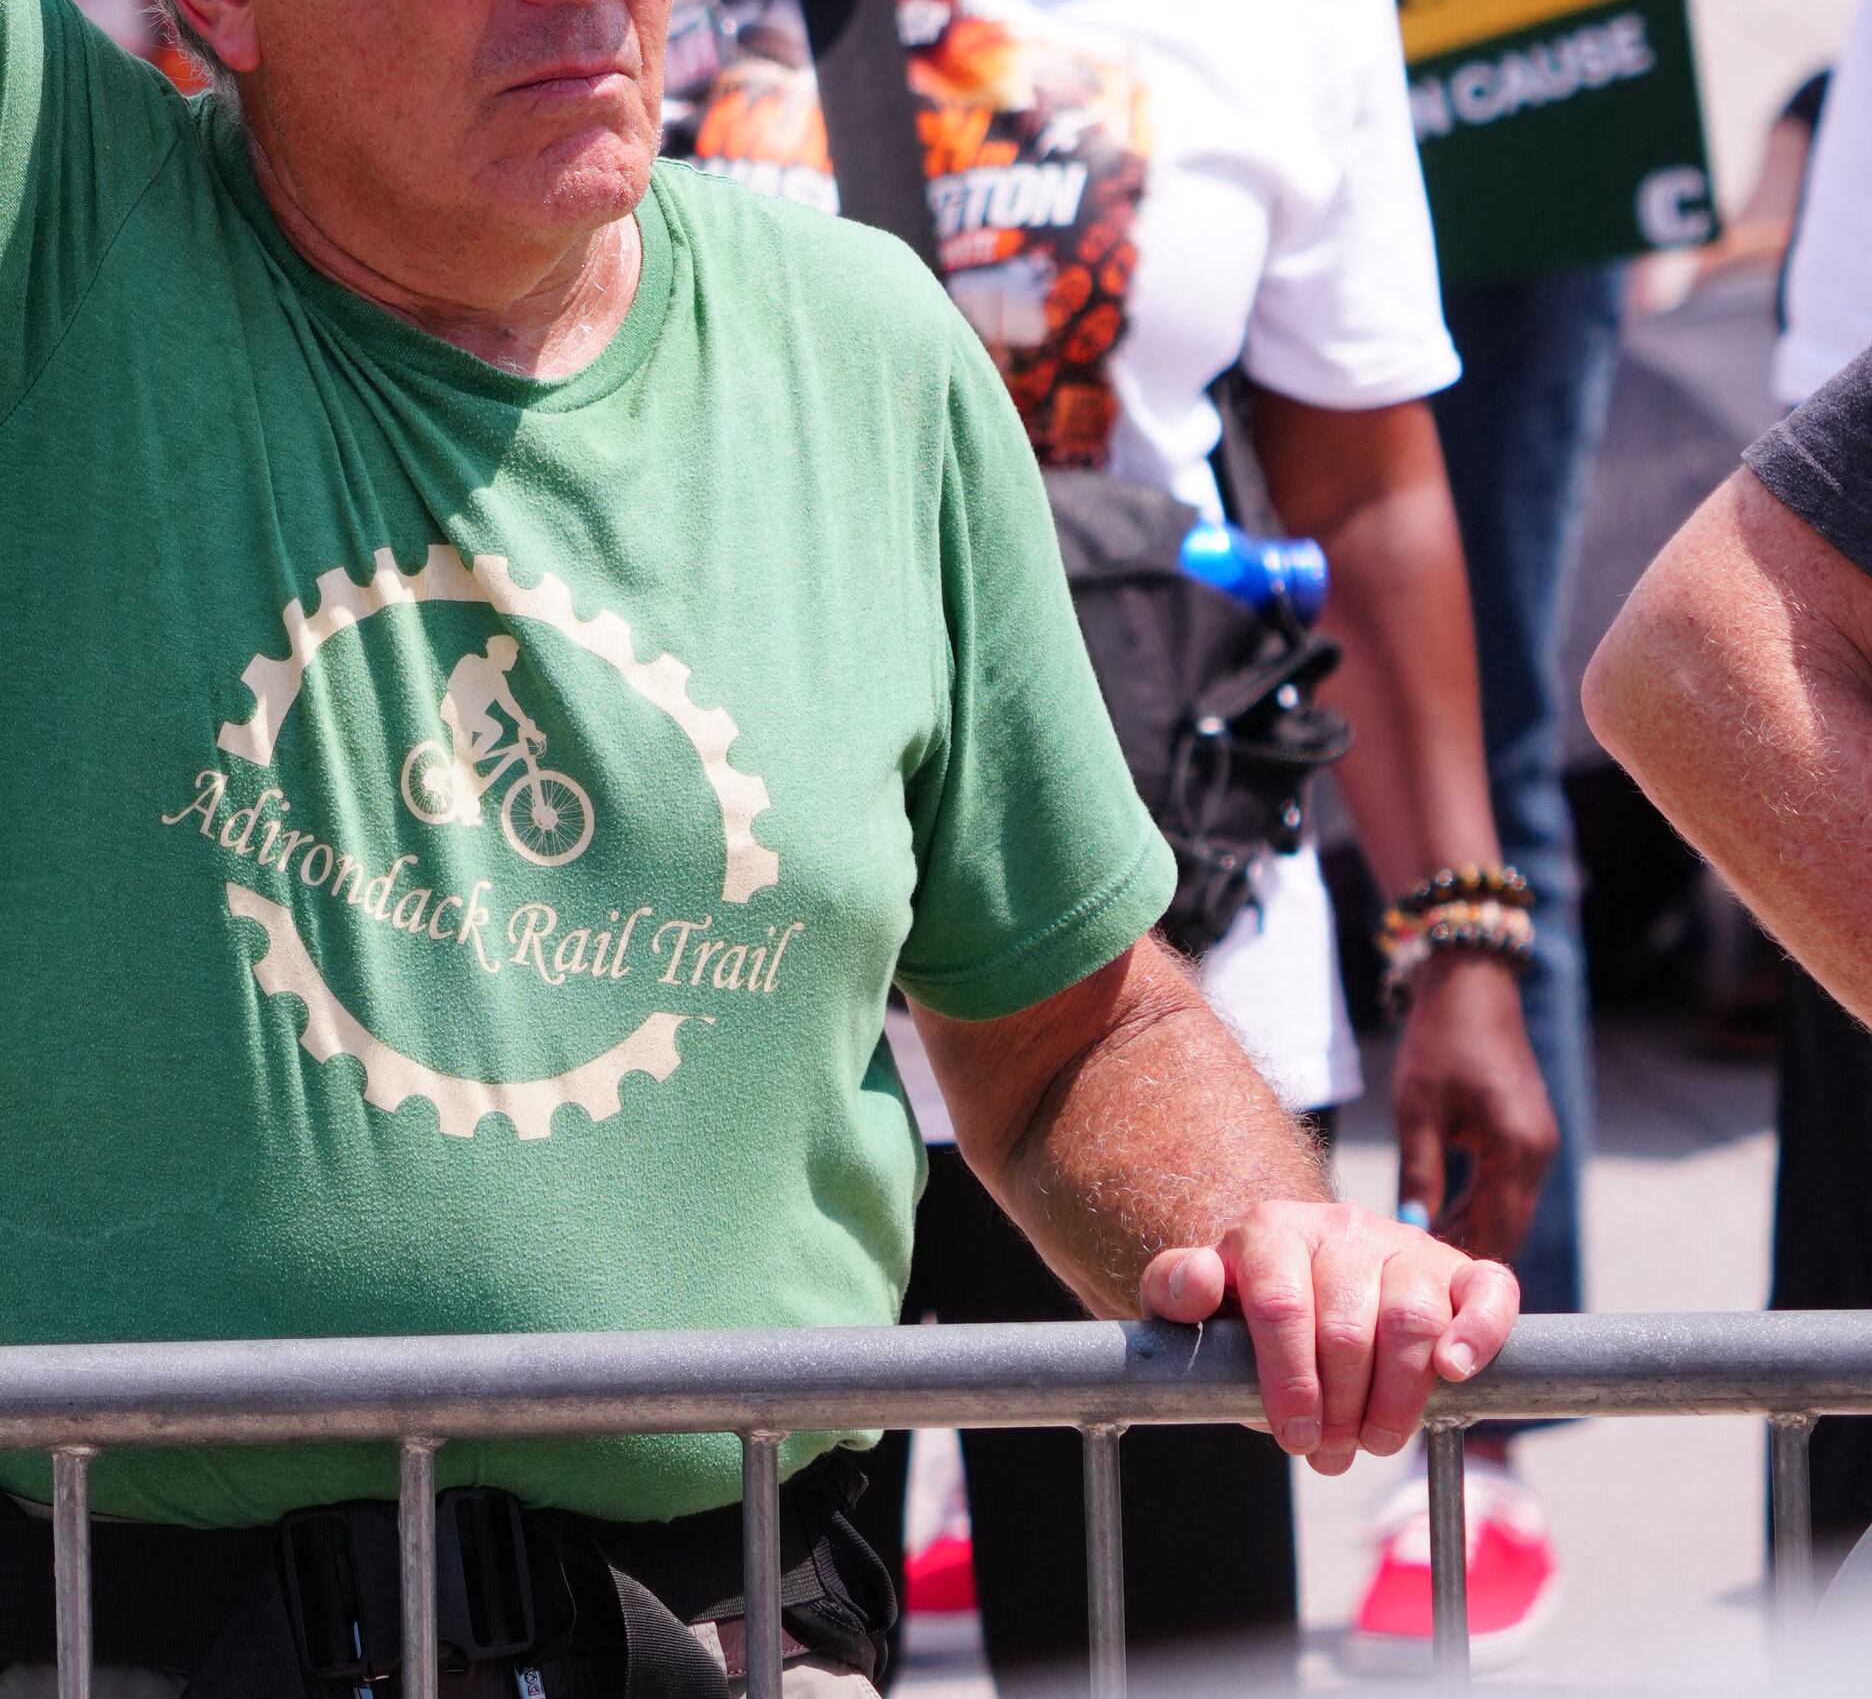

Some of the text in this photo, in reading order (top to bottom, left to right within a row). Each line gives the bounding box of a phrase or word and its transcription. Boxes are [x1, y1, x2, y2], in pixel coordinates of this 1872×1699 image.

[1449, 11, 1656, 126] CAUSE
[161, 769, 806, 995] Adirondack Rail Trail
